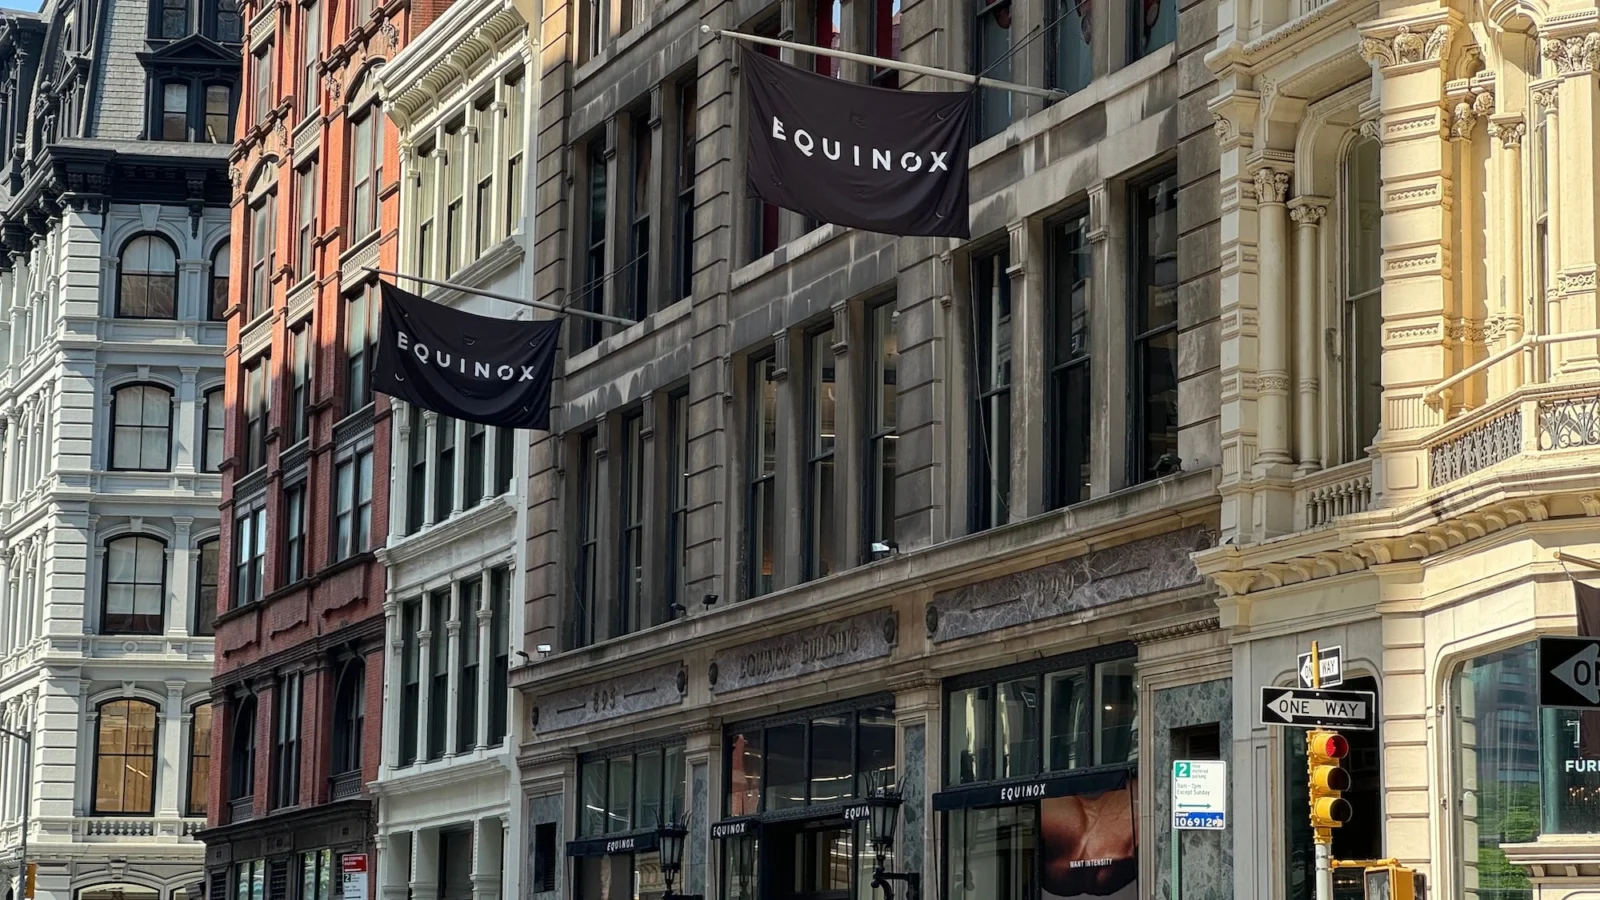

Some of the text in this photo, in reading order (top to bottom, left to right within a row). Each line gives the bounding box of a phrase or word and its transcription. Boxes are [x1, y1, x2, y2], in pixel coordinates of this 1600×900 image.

[772, 116, 948, 173] EQUINOX
[397, 331, 534, 382] EQUINOX
[740, 628, 859, 679] EQUINOX BUILDING
[1323, 659, 1336, 676] WAY
[593, 687, 616, 713] 895
[1279, 699, 1358, 717] ONE WAY
[1178, 763, 1187, 777] 2
[1001, 783, 1046, 801] EQUINOX
[844, 805, 870, 820] EQUIN
[713, 822, 746, 838] EQUINOX
[606, 838, 635, 852] EQUINOX
[1069, 858, 1113, 869] WANT INTENSITY
